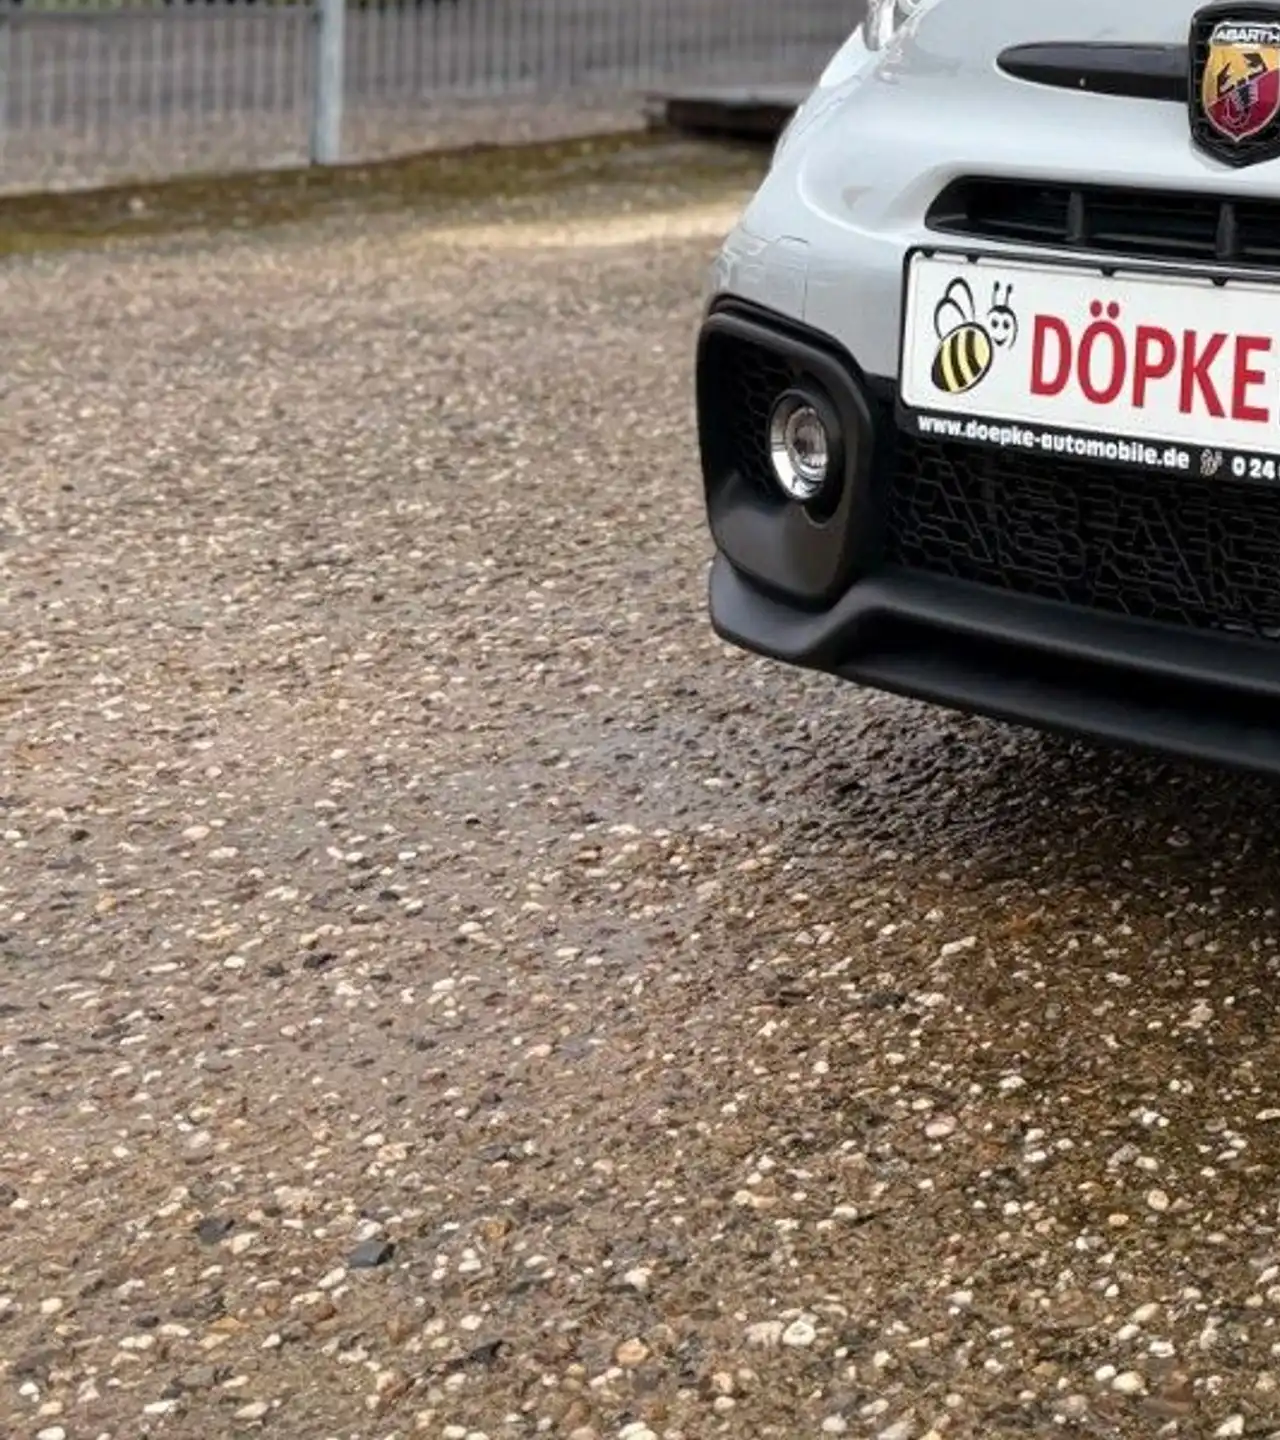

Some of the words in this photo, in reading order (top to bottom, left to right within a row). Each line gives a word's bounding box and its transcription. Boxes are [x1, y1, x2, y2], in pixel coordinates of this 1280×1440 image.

[1216, 28, 1280, 43] ABARTH
[1030, 301, 1271, 423] DÖPKE
[917, 414, 1190, 469] www.doepke-automobile.de
